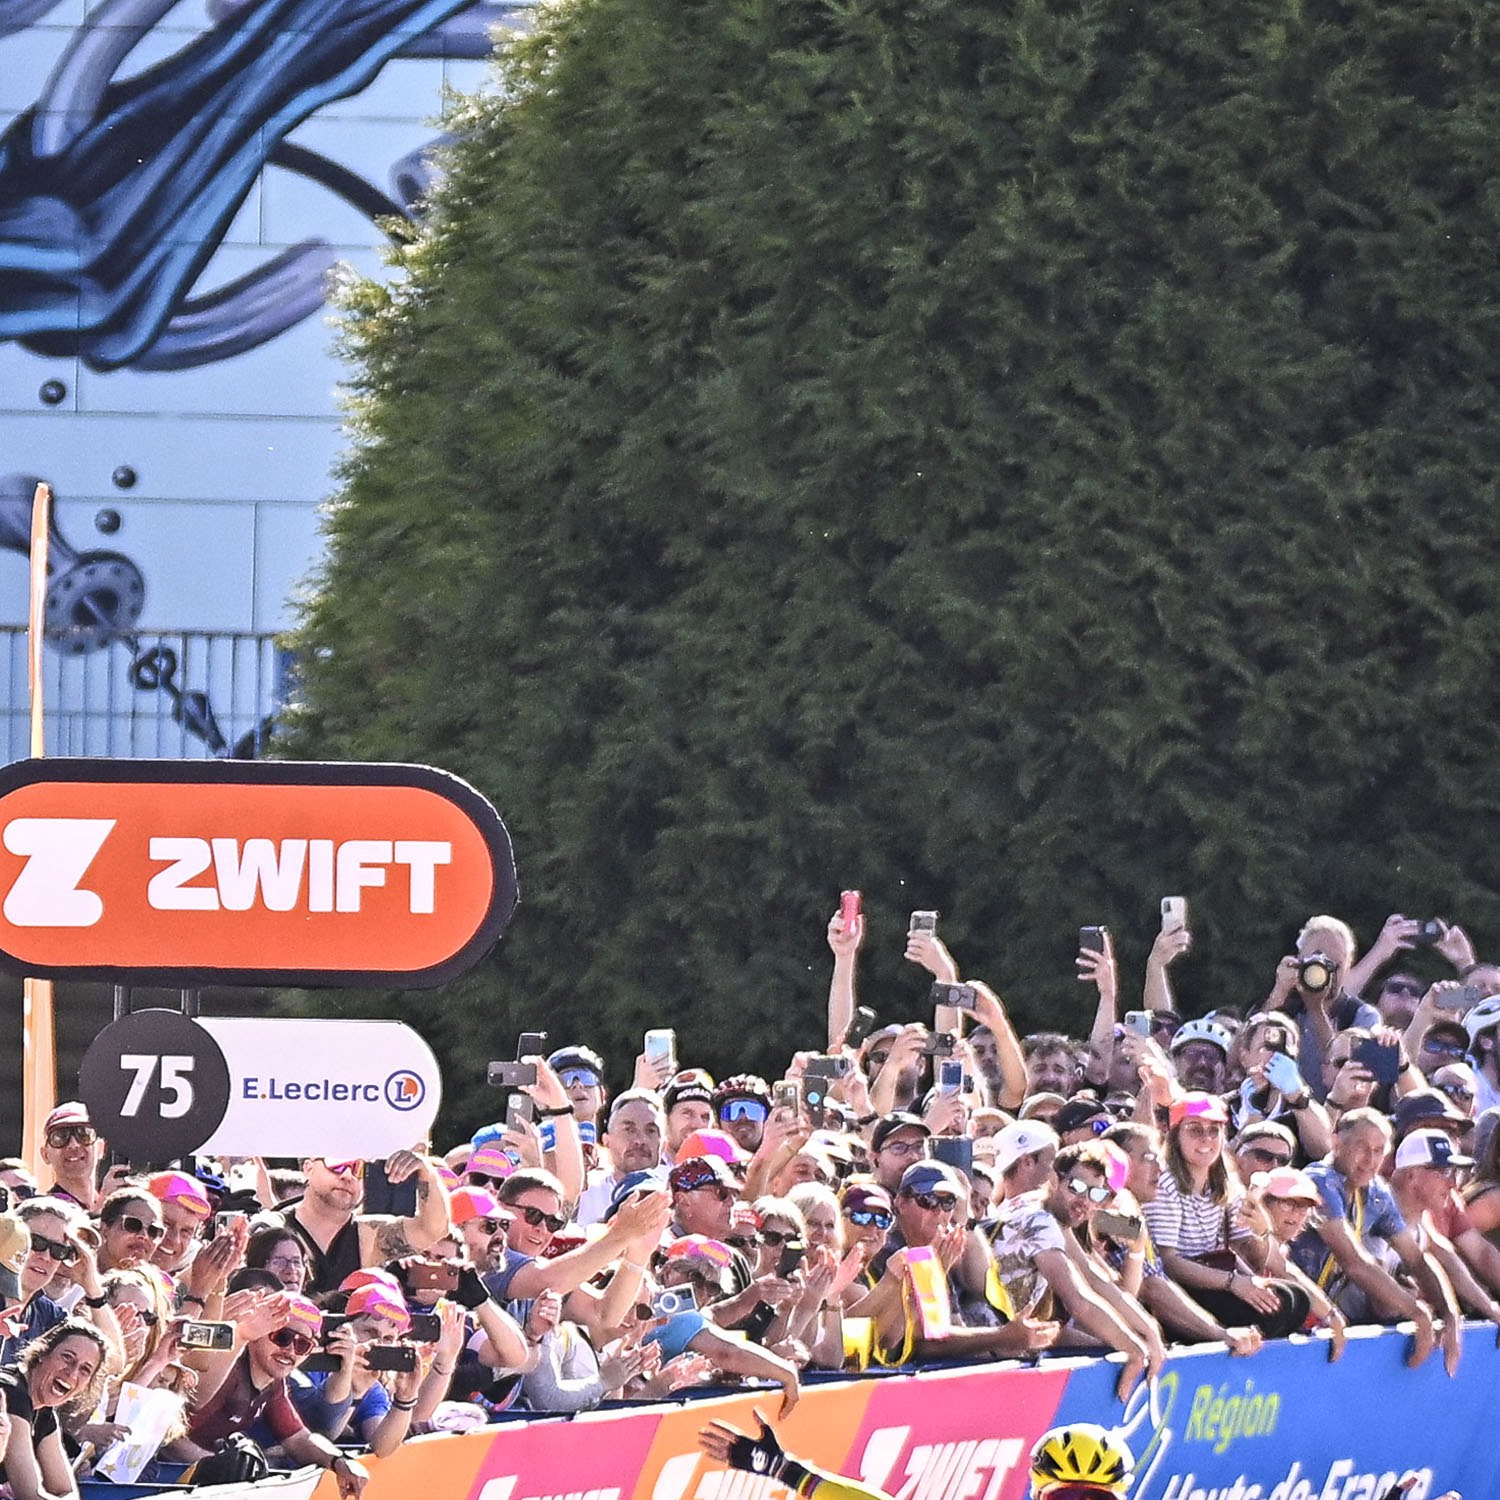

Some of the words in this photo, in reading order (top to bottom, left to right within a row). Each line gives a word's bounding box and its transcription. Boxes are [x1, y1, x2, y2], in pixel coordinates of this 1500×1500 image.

[147, 837, 452, 913] ZWIFT
[119, 1054, 195, 1118] 75
[242, 1076, 380, 1104] E.Leclerc
[1184, 1380, 1281, 1453] Région
